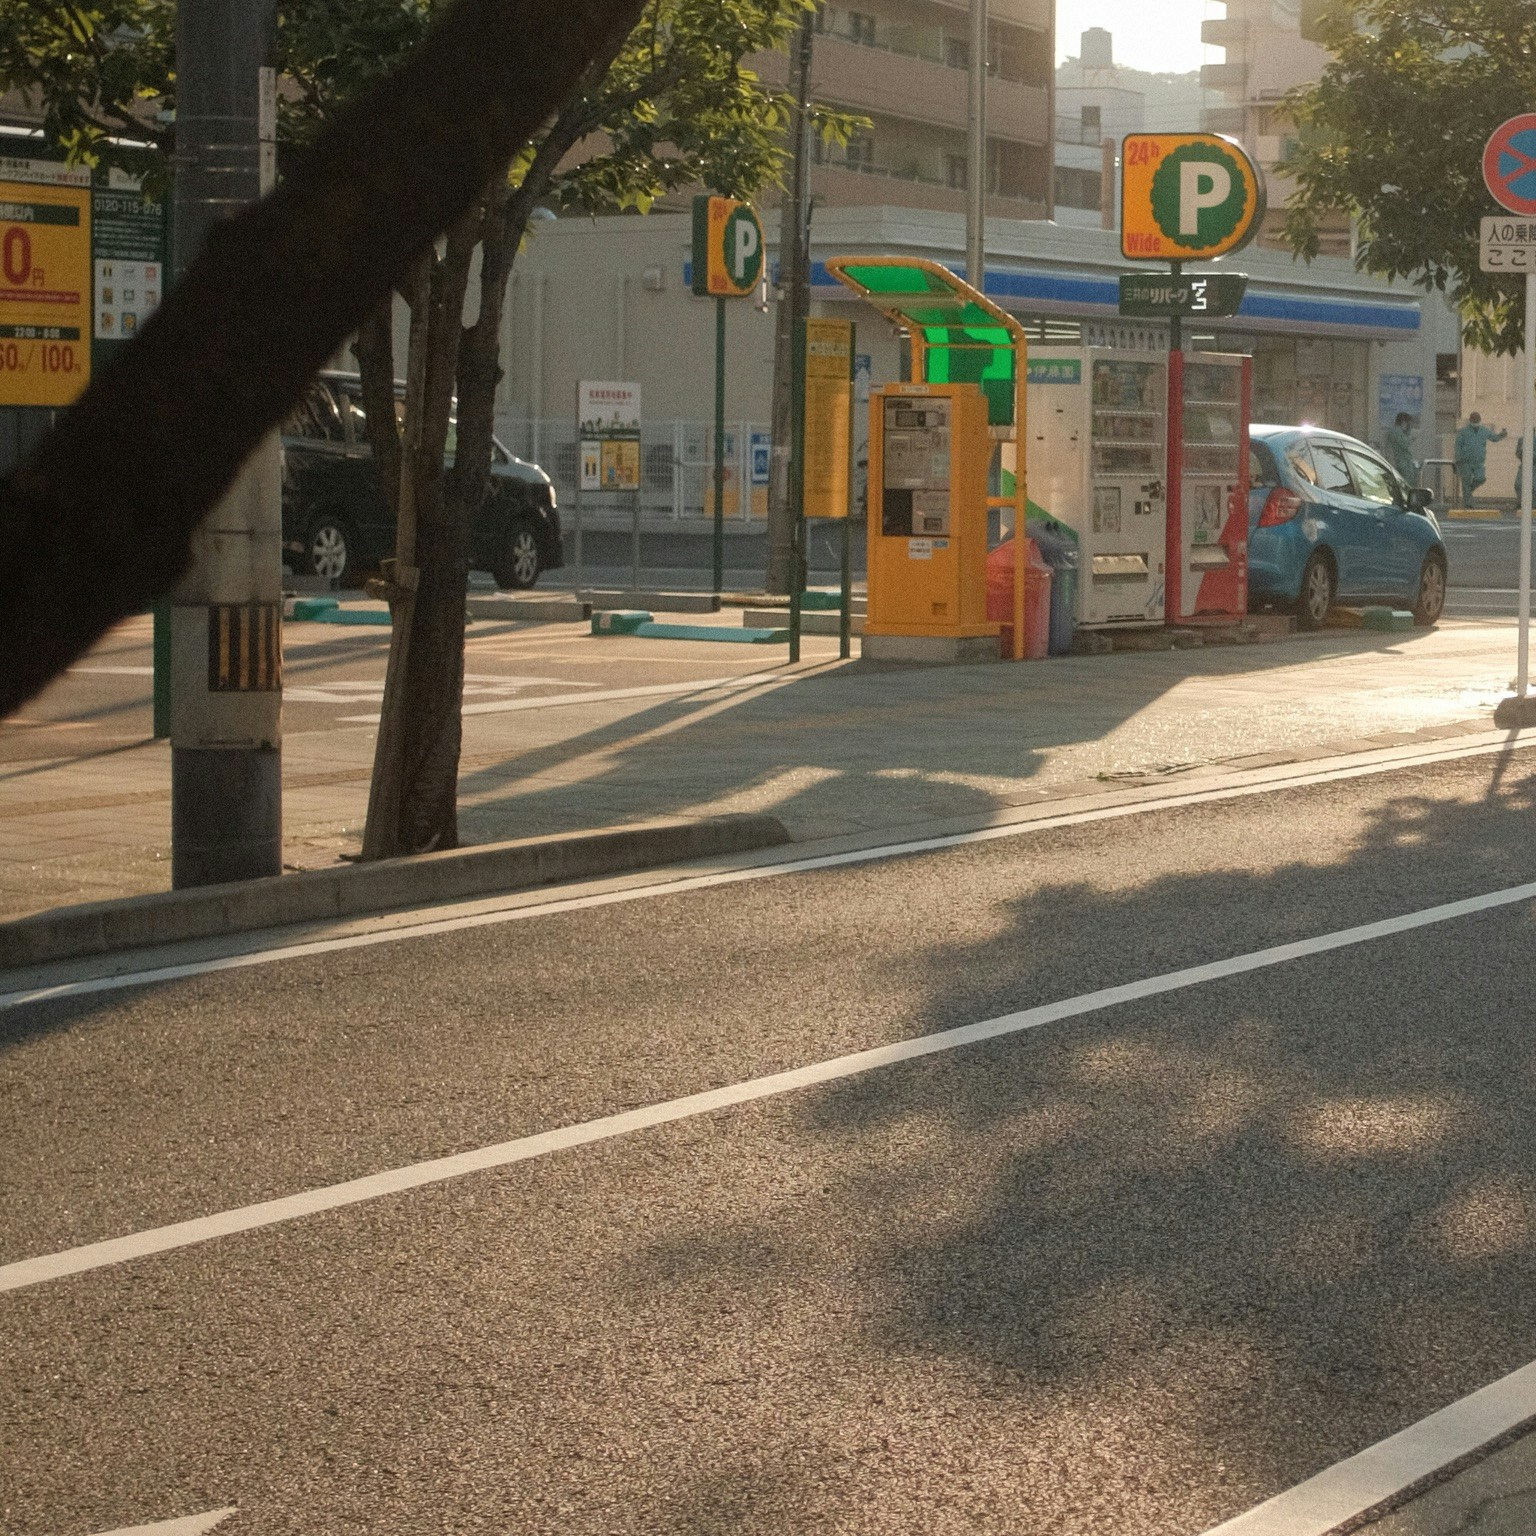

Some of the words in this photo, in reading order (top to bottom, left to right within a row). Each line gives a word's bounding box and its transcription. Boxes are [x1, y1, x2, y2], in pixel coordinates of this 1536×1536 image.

[1179, 161, 1232, 236] P
[735, 219, 758, 279] P
[1126, 233, 1162, 252] Wide
